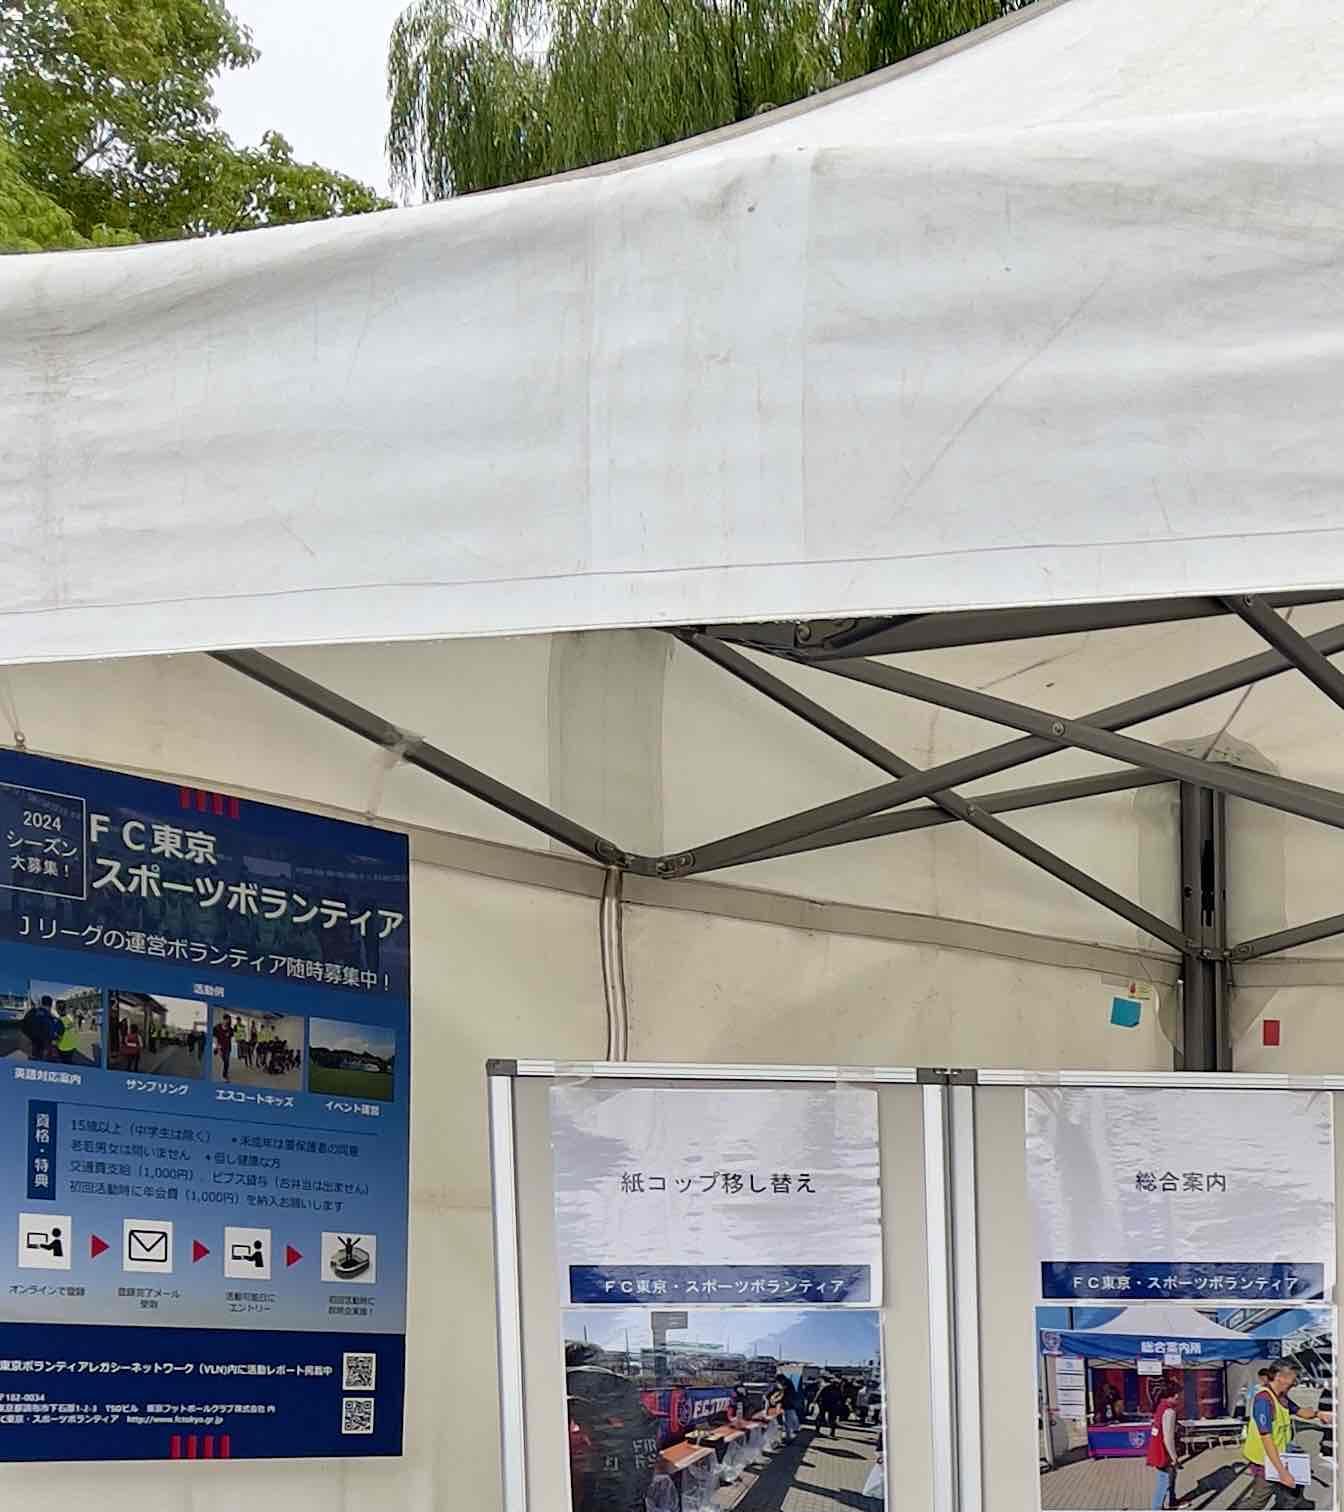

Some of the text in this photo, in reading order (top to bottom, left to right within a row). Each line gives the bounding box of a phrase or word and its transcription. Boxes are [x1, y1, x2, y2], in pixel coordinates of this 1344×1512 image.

[23, 810, 62, 832] 2024
[6, 830, 78, 858] シーズン
[89, 813, 218, 865] FC東京
[92, 857, 405, 940] スポーツボランティア
[126, 1078, 190, 1096] サンプリング
[620, 1171, 818, 1196] 紙コップ移し替え
[1135, 1171, 1228, 1194] 総合案内
